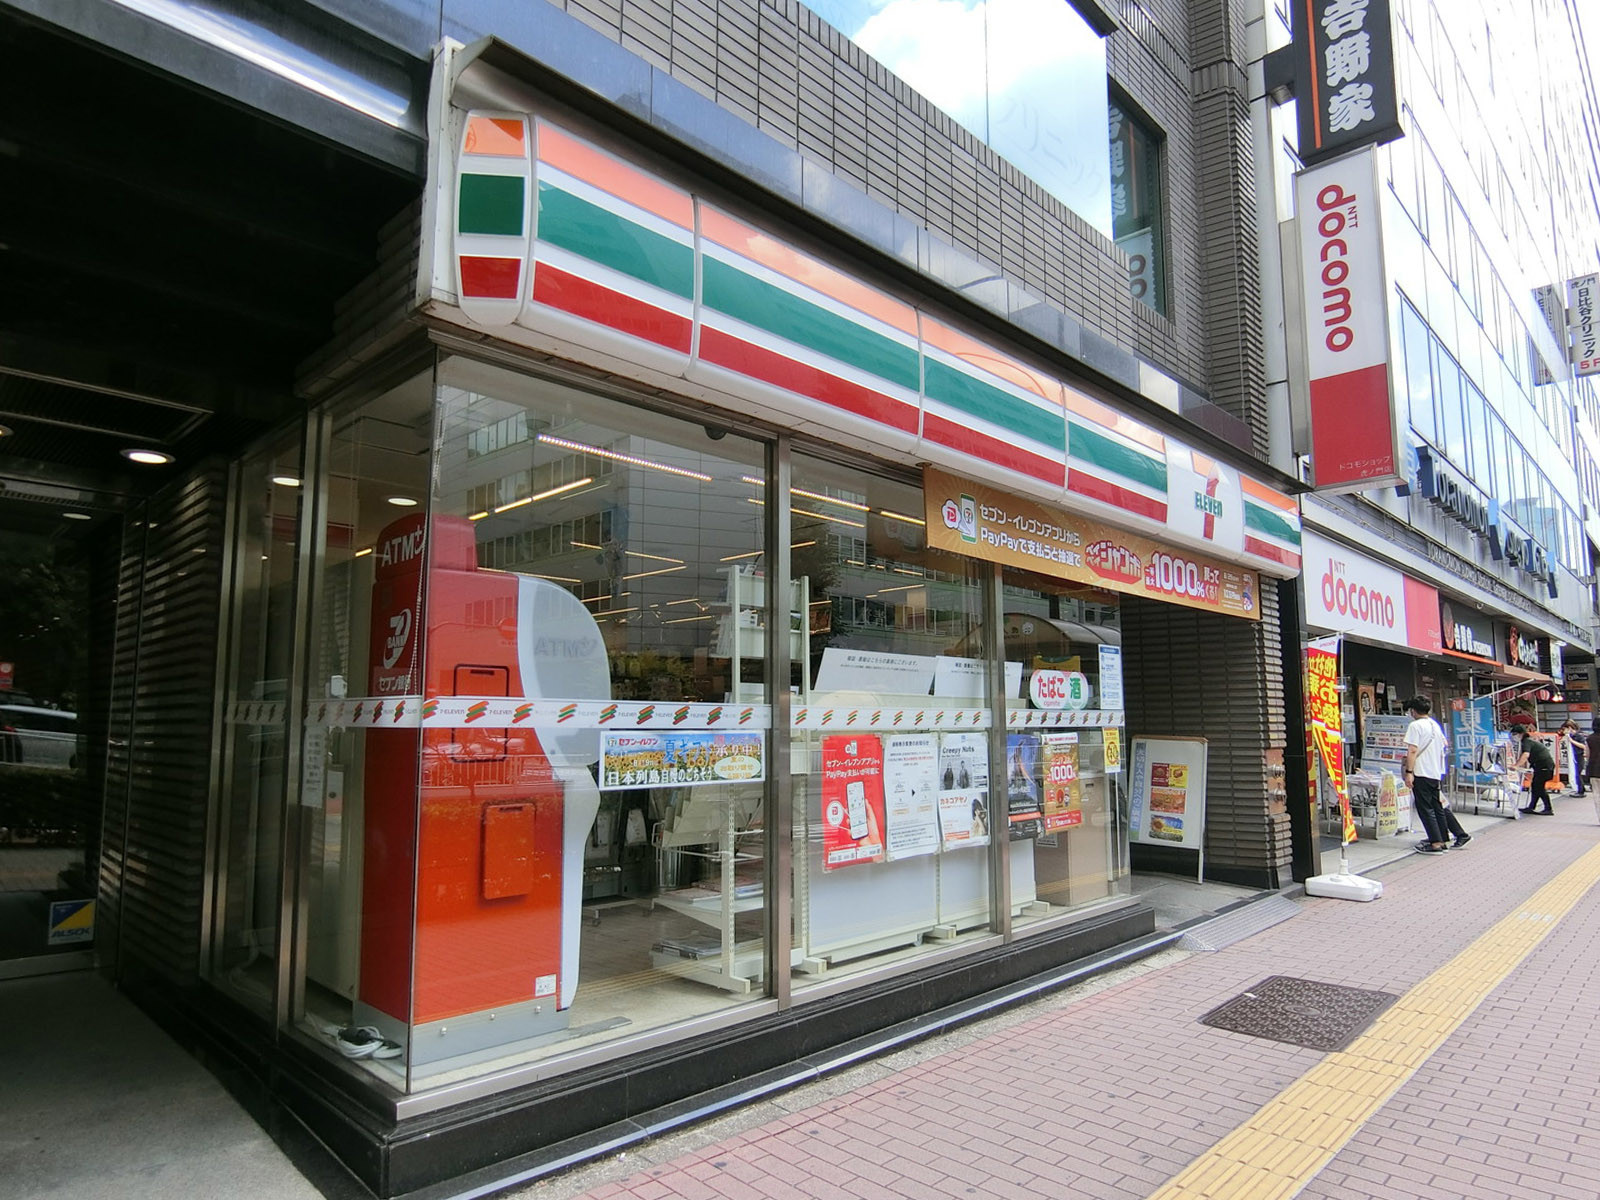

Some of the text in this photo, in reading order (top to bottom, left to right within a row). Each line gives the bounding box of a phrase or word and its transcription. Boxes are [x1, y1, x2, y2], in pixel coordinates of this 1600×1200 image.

[1321, 0, 1375, 133] 吉野家
[1347, 205, 1359, 229] NTT
[1316, 183, 1356, 353] docomo
[1571, 277, 1596, 289] 虎ノ門
[1578, 287, 1597, 359] 日比谷クリニック
[1339, 455, 1391, 471] ドコモショップ
[381, 532, 415, 568] ATM
[980, 526, 1082, 568] PayPayで支払うと抽選で
[1100, 541, 1141, 578] ジャンボ
[1152, 551, 1205, 599] 1000%
[1333, 559, 1346, 575] NTT
[1321, 557, 1395, 629] docomo
[1037, 675, 1082, 700] たばこ 酒
[942, 746, 961, 755] Creepy
[51, 927, 90, 938] ALSOK
